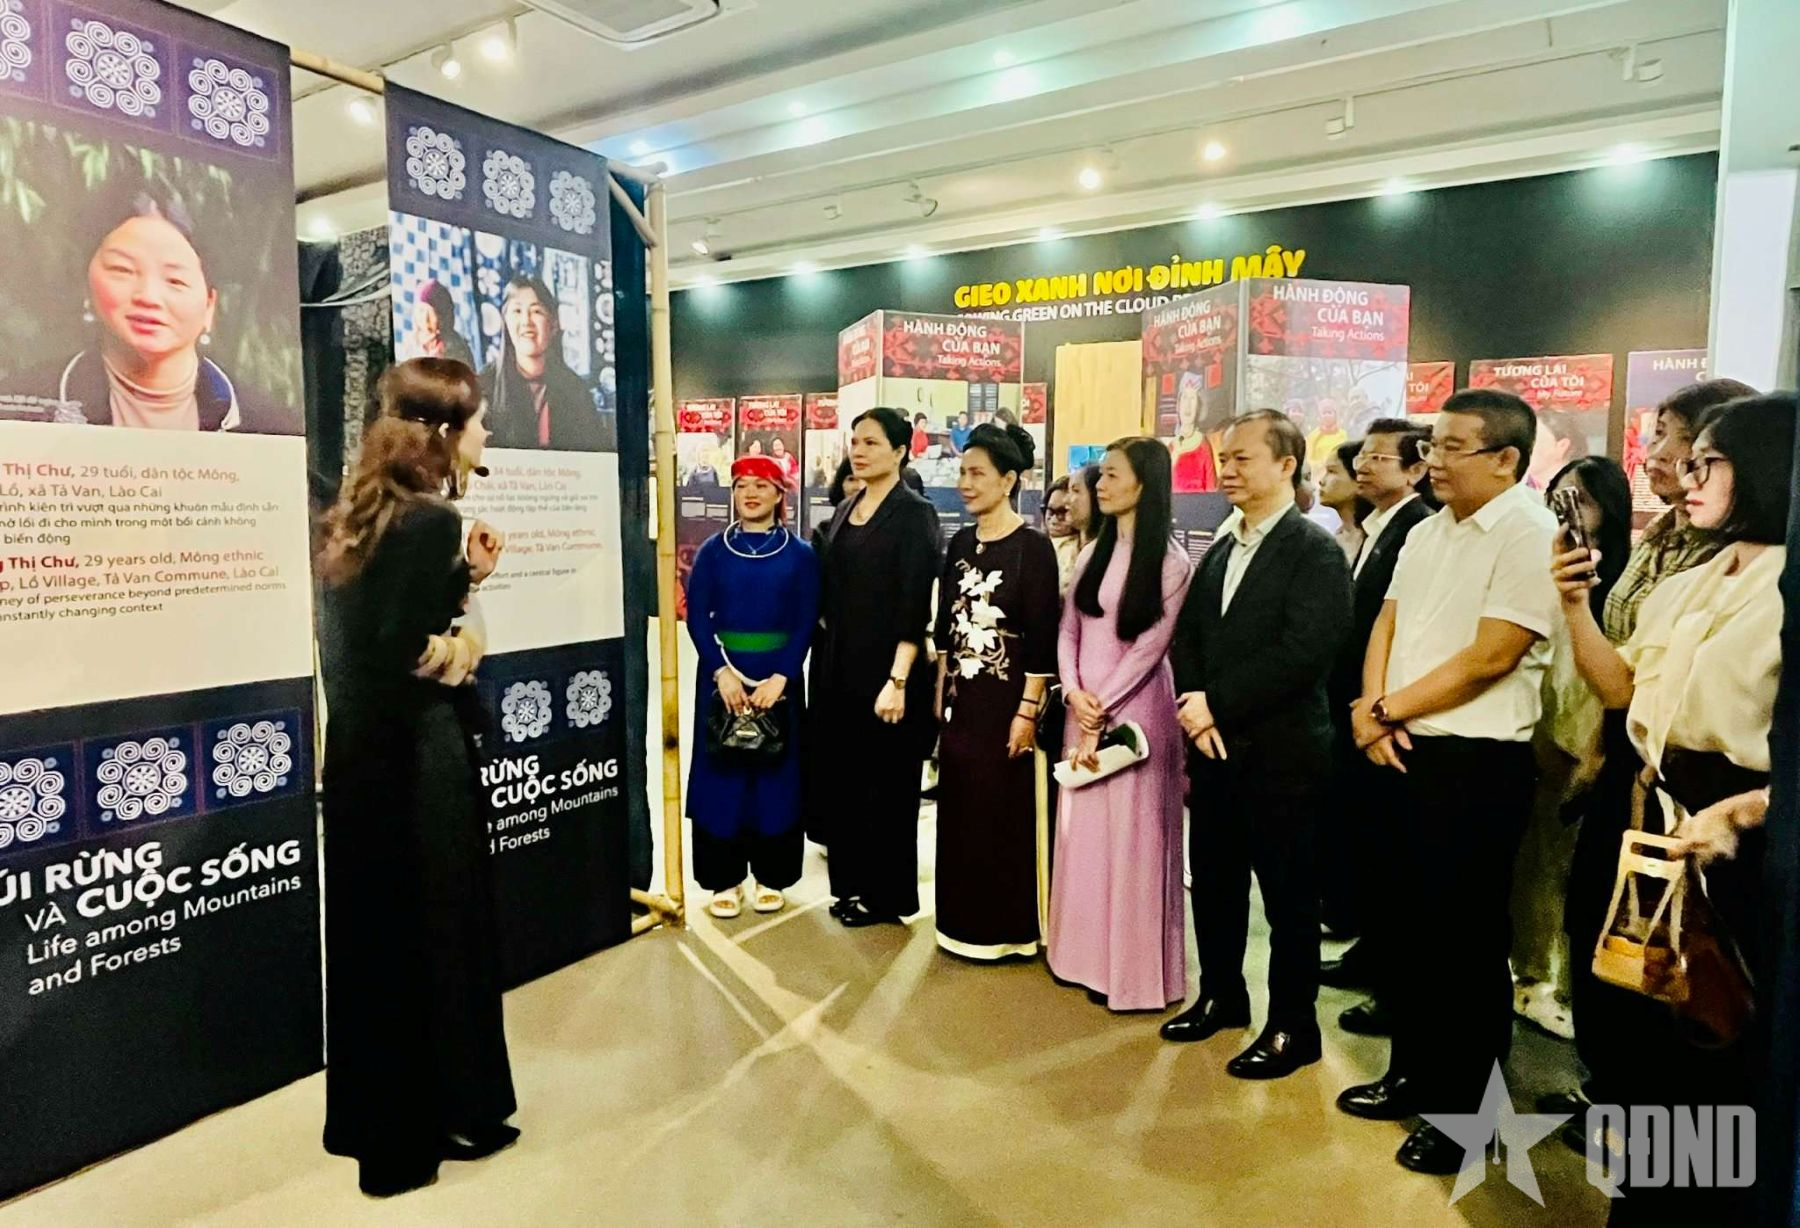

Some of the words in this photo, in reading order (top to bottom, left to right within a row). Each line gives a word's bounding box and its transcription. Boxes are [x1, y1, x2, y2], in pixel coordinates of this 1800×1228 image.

[954, 282, 1011, 308] GIEO
[1016, 273, 1087, 303] XANH
[1093, 265, 1143, 295] NƠI
[1146, 255, 1224, 290] ĐỈNH
[1231, 245, 1306, 281] MÂY
[1273, 284, 1319, 302] HÀNH
[1322, 287, 1369, 305] ĐỘNG
[1012, 305, 1058, 321] GREEN
[1060, 303, 1083, 319] ON
[1084, 300, 1113, 317] THE
[1154, 308, 1180, 328] HÀNH
[1317, 304, 1348, 323] CỦA
[1352, 309, 1384, 328] BẠN
[904, 319, 944, 336] HÀNH
[947, 322, 987, 338] ĐỘNG
[1199, 315, 1221, 335] BẠN
[1311, 327, 1344, 341] Taking
[1347, 330, 1385, 341] Actions
[942, 337, 968, 352] CỦA
[972, 341, 1000, 358] BẠN
[938, 355, 966, 367] Taking
[969, 357, 1001, 367] Actions
[1545, 364, 1567, 375] LAI
[1653, 357, 1698, 370] HÀNH
[1410, 382, 1429, 391] TÔI
[1562, 376, 1584, 386] TÔI
[2, 463, 31, 479] Thị
[36, 463, 75, 478] Chư,
[80, 465, 99, 478] 29
[103, 465, 137, 479] tuổi,
[141, 467, 168, 479] dân
[172, 469, 195, 481] tộc
[71, 485, 105, 498] Van,
[140, 485, 162, 498] Cai
[29, 501, 56, 512] kiên
[76, 502, 104, 513] vượt
[108, 504, 130, 514] qua
[38, 518, 51, 528] đi
[54, 518, 77, 528] cho
[80, 518, 112, 527] mình
[115, 518, 147, 528] trong
[150, 518, 172, 527] một
[224, 517, 257, 528] không
[4, 533, 33, 544] biến
[37, 533, 71, 545] động
[8, 556, 36, 572] Thị
[40, 555, 80, 569] Chư,
[84, 554, 103, 567] 29
[107, 554, 146, 568] years
[149, 552, 176, 564] old,
[180, 551, 219, 565] Mông
[223, 549, 264, 562] ethnic
[42, 573, 100, 589] Village,
[123, 572, 150, 584] Van
[154, 569, 229, 583] Commune,
[259, 565, 279, 577] Cai
[27, 594, 40, 605] of
[44, 590, 126, 605] perseverance
[128, 587, 172, 600] beyond
[174, 582, 252, 598] predetermined
[254, 581, 286, 592] norms
[58, 604, 117, 618] changing
[119, 602, 163, 614] context
[491, 774, 557, 808] CUỘC
[560, 758, 619, 790] SỐNG
[496, 806, 548, 831] among
[551, 786, 619, 815] Mountains
[500, 827, 551, 852] Forests
[45, 841, 162, 893] RỪNG
[24, 902, 67, 933] VÀ
[76, 866, 193, 918] CUỘC
[200, 841, 301, 886] SỐNG
[27, 935, 78, 965] Life
[86, 909, 176, 949] among
[183, 874, 302, 919] Mountains
[27, 960, 82, 996] and
[90, 936, 182, 977] Forests
